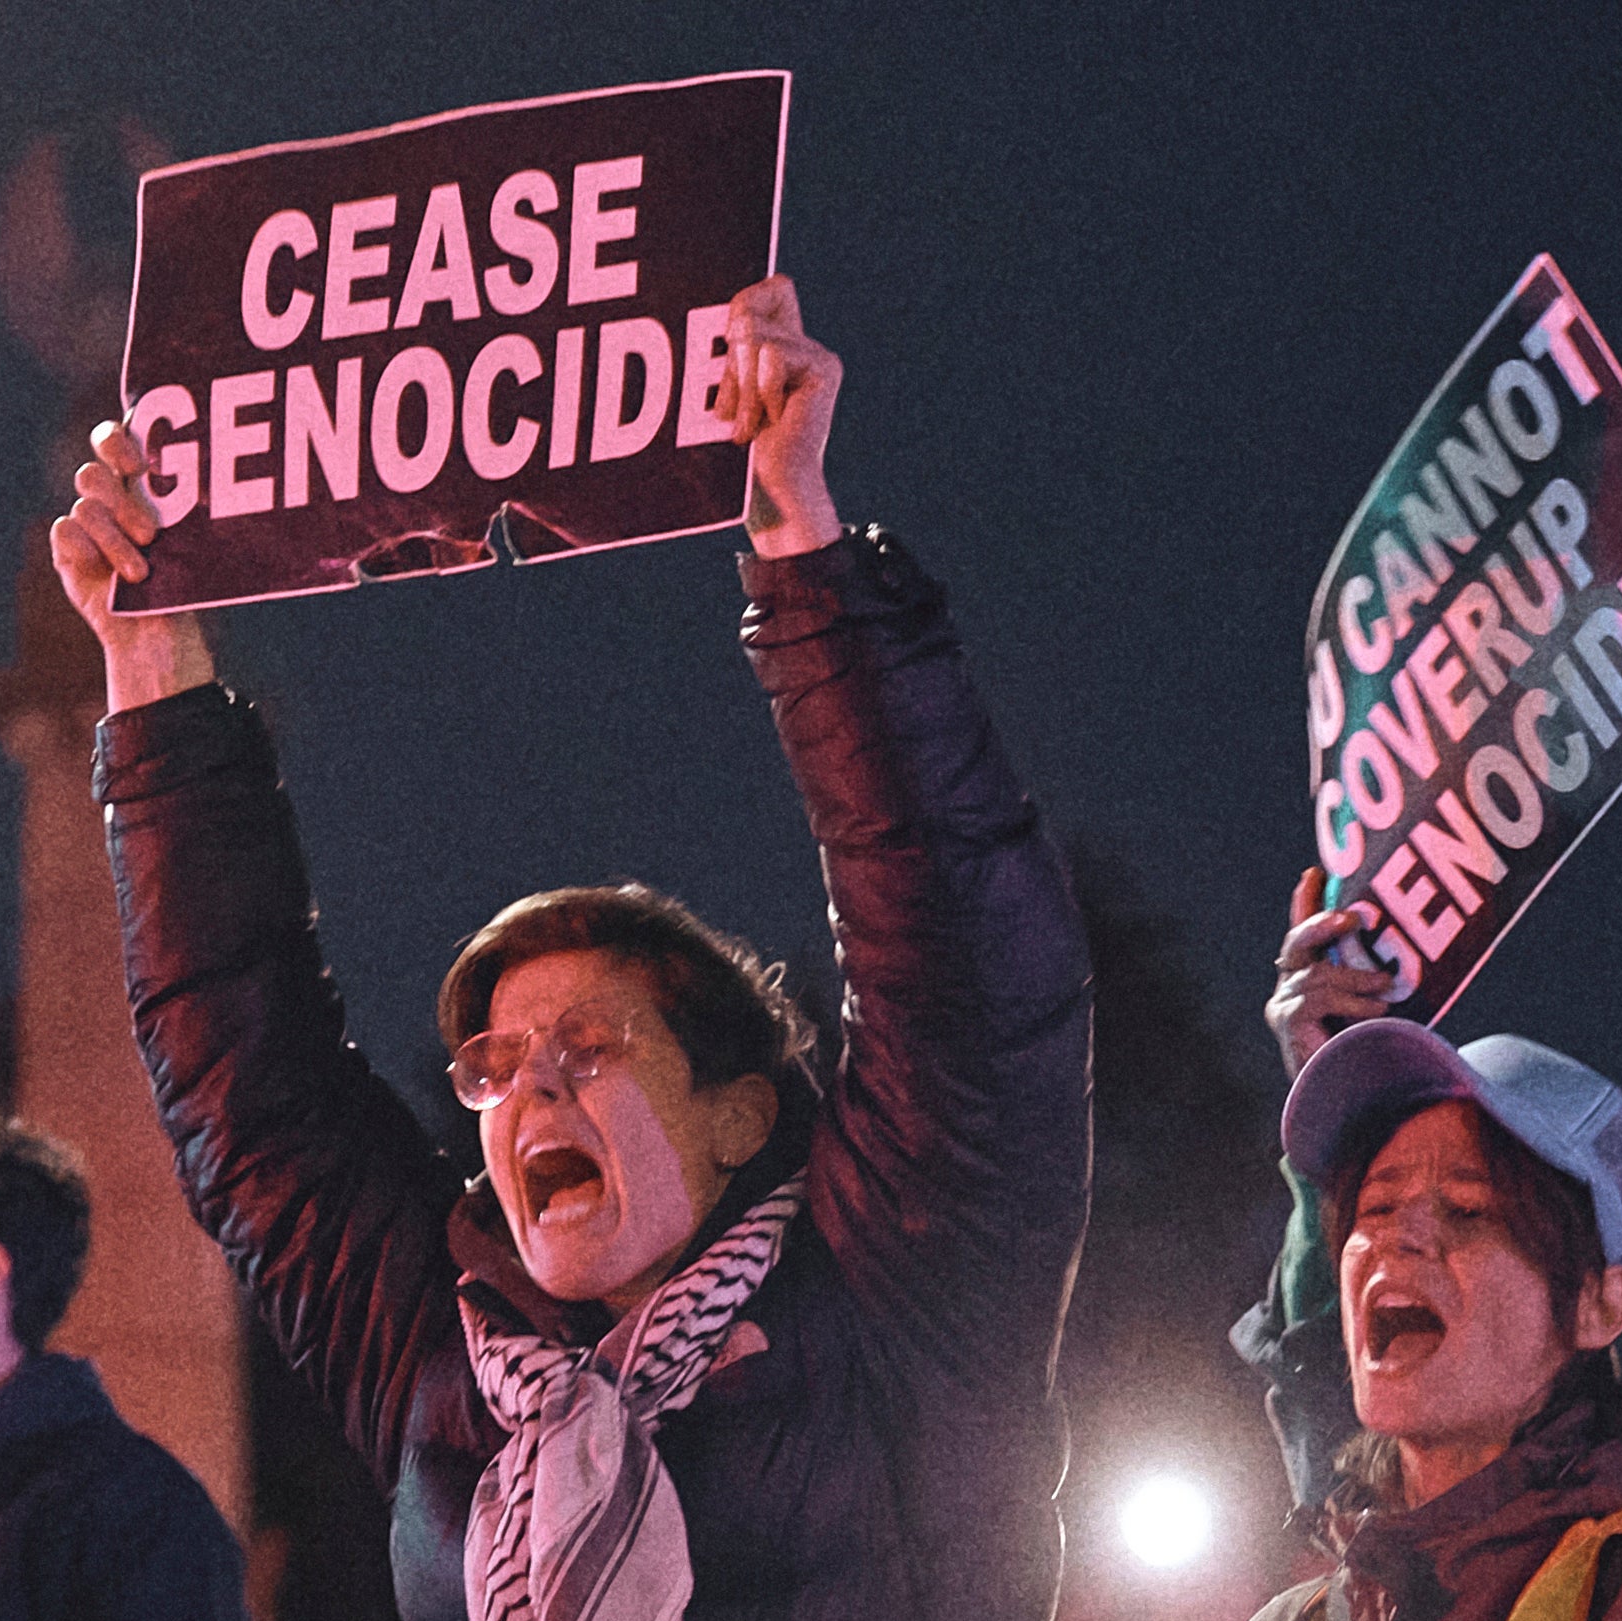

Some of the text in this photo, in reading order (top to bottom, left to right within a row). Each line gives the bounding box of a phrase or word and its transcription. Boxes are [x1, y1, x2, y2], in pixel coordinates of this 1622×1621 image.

[240, 154, 644, 351] CEASE
[131, 303, 735, 529] GENOCIDE
[1336, 296, 1602, 675] CANNOT
[1315, 477, 1595, 879] COVERUP
